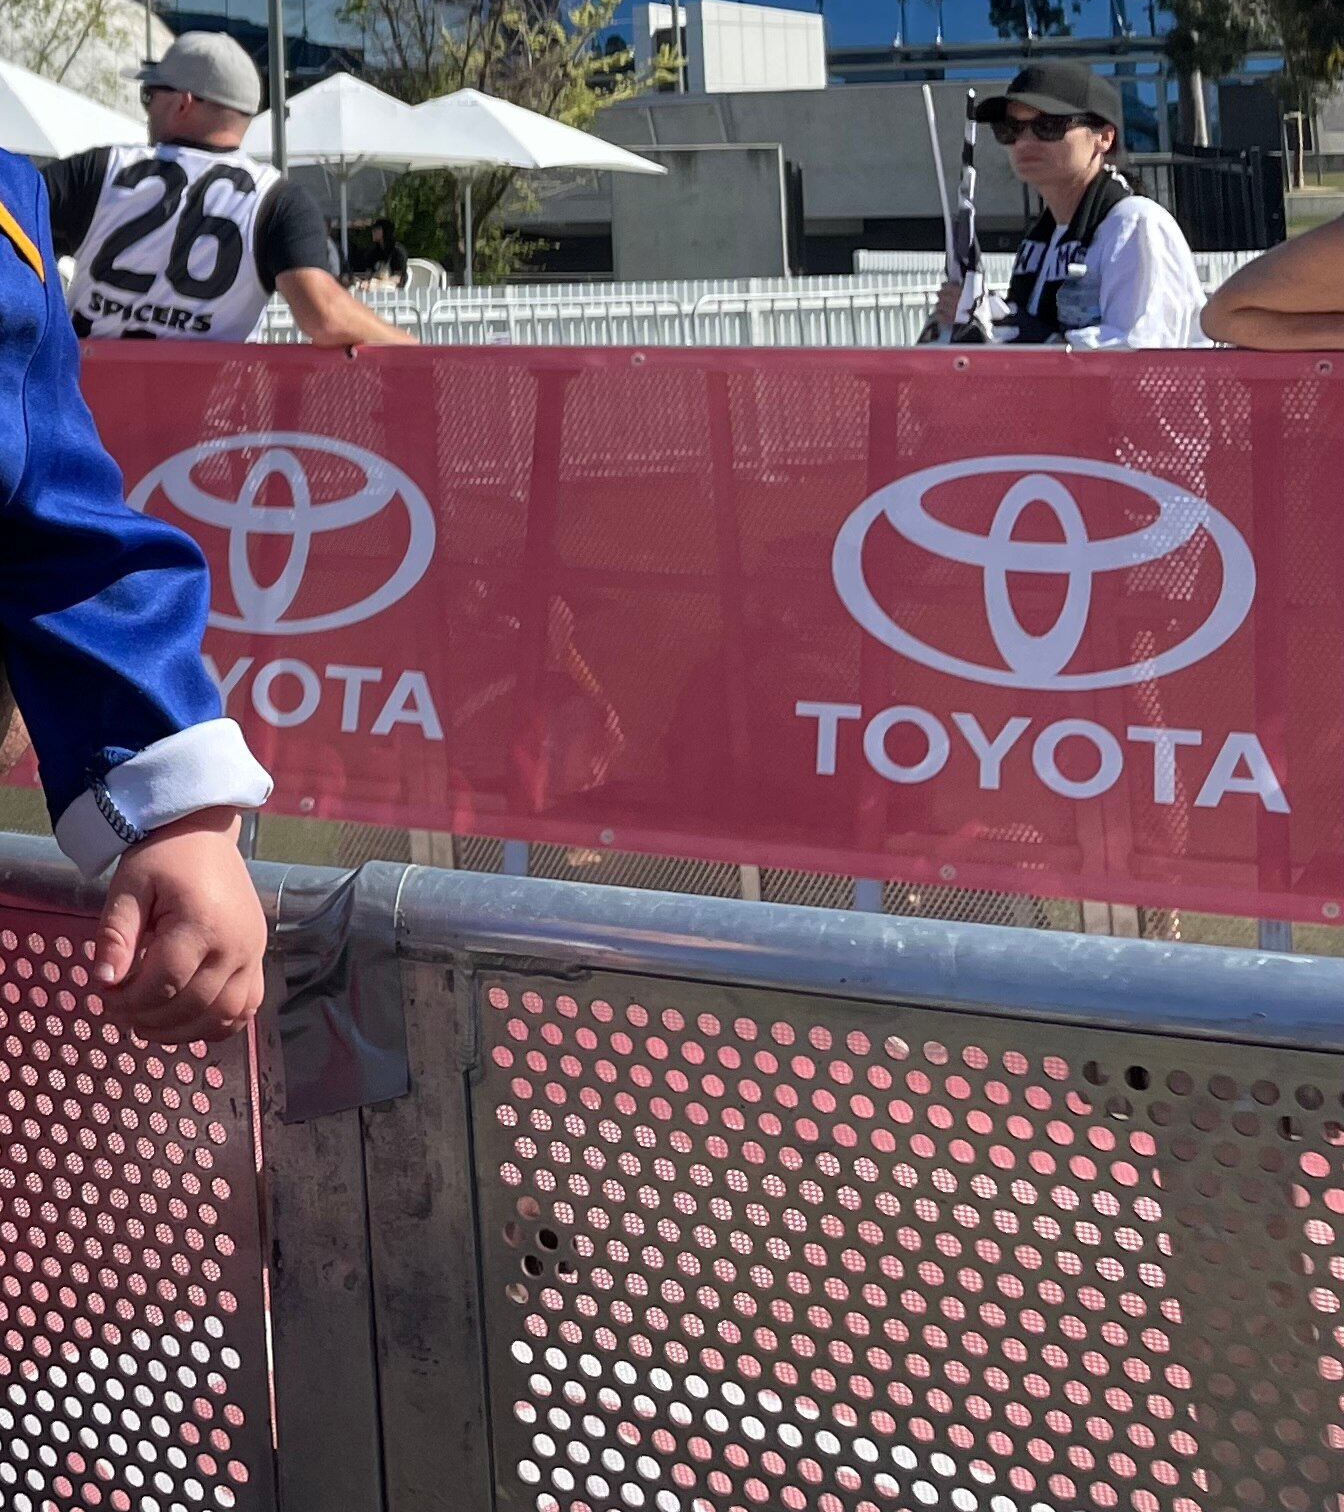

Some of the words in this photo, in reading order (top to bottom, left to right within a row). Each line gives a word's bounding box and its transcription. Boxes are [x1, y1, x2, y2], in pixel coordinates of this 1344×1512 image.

[89, 159, 255, 299] 26
[88, 291, 213, 332] SPICERS
[201, 653, 444, 741] YOTA
[794, 699, 1292, 815] TOYOTA
